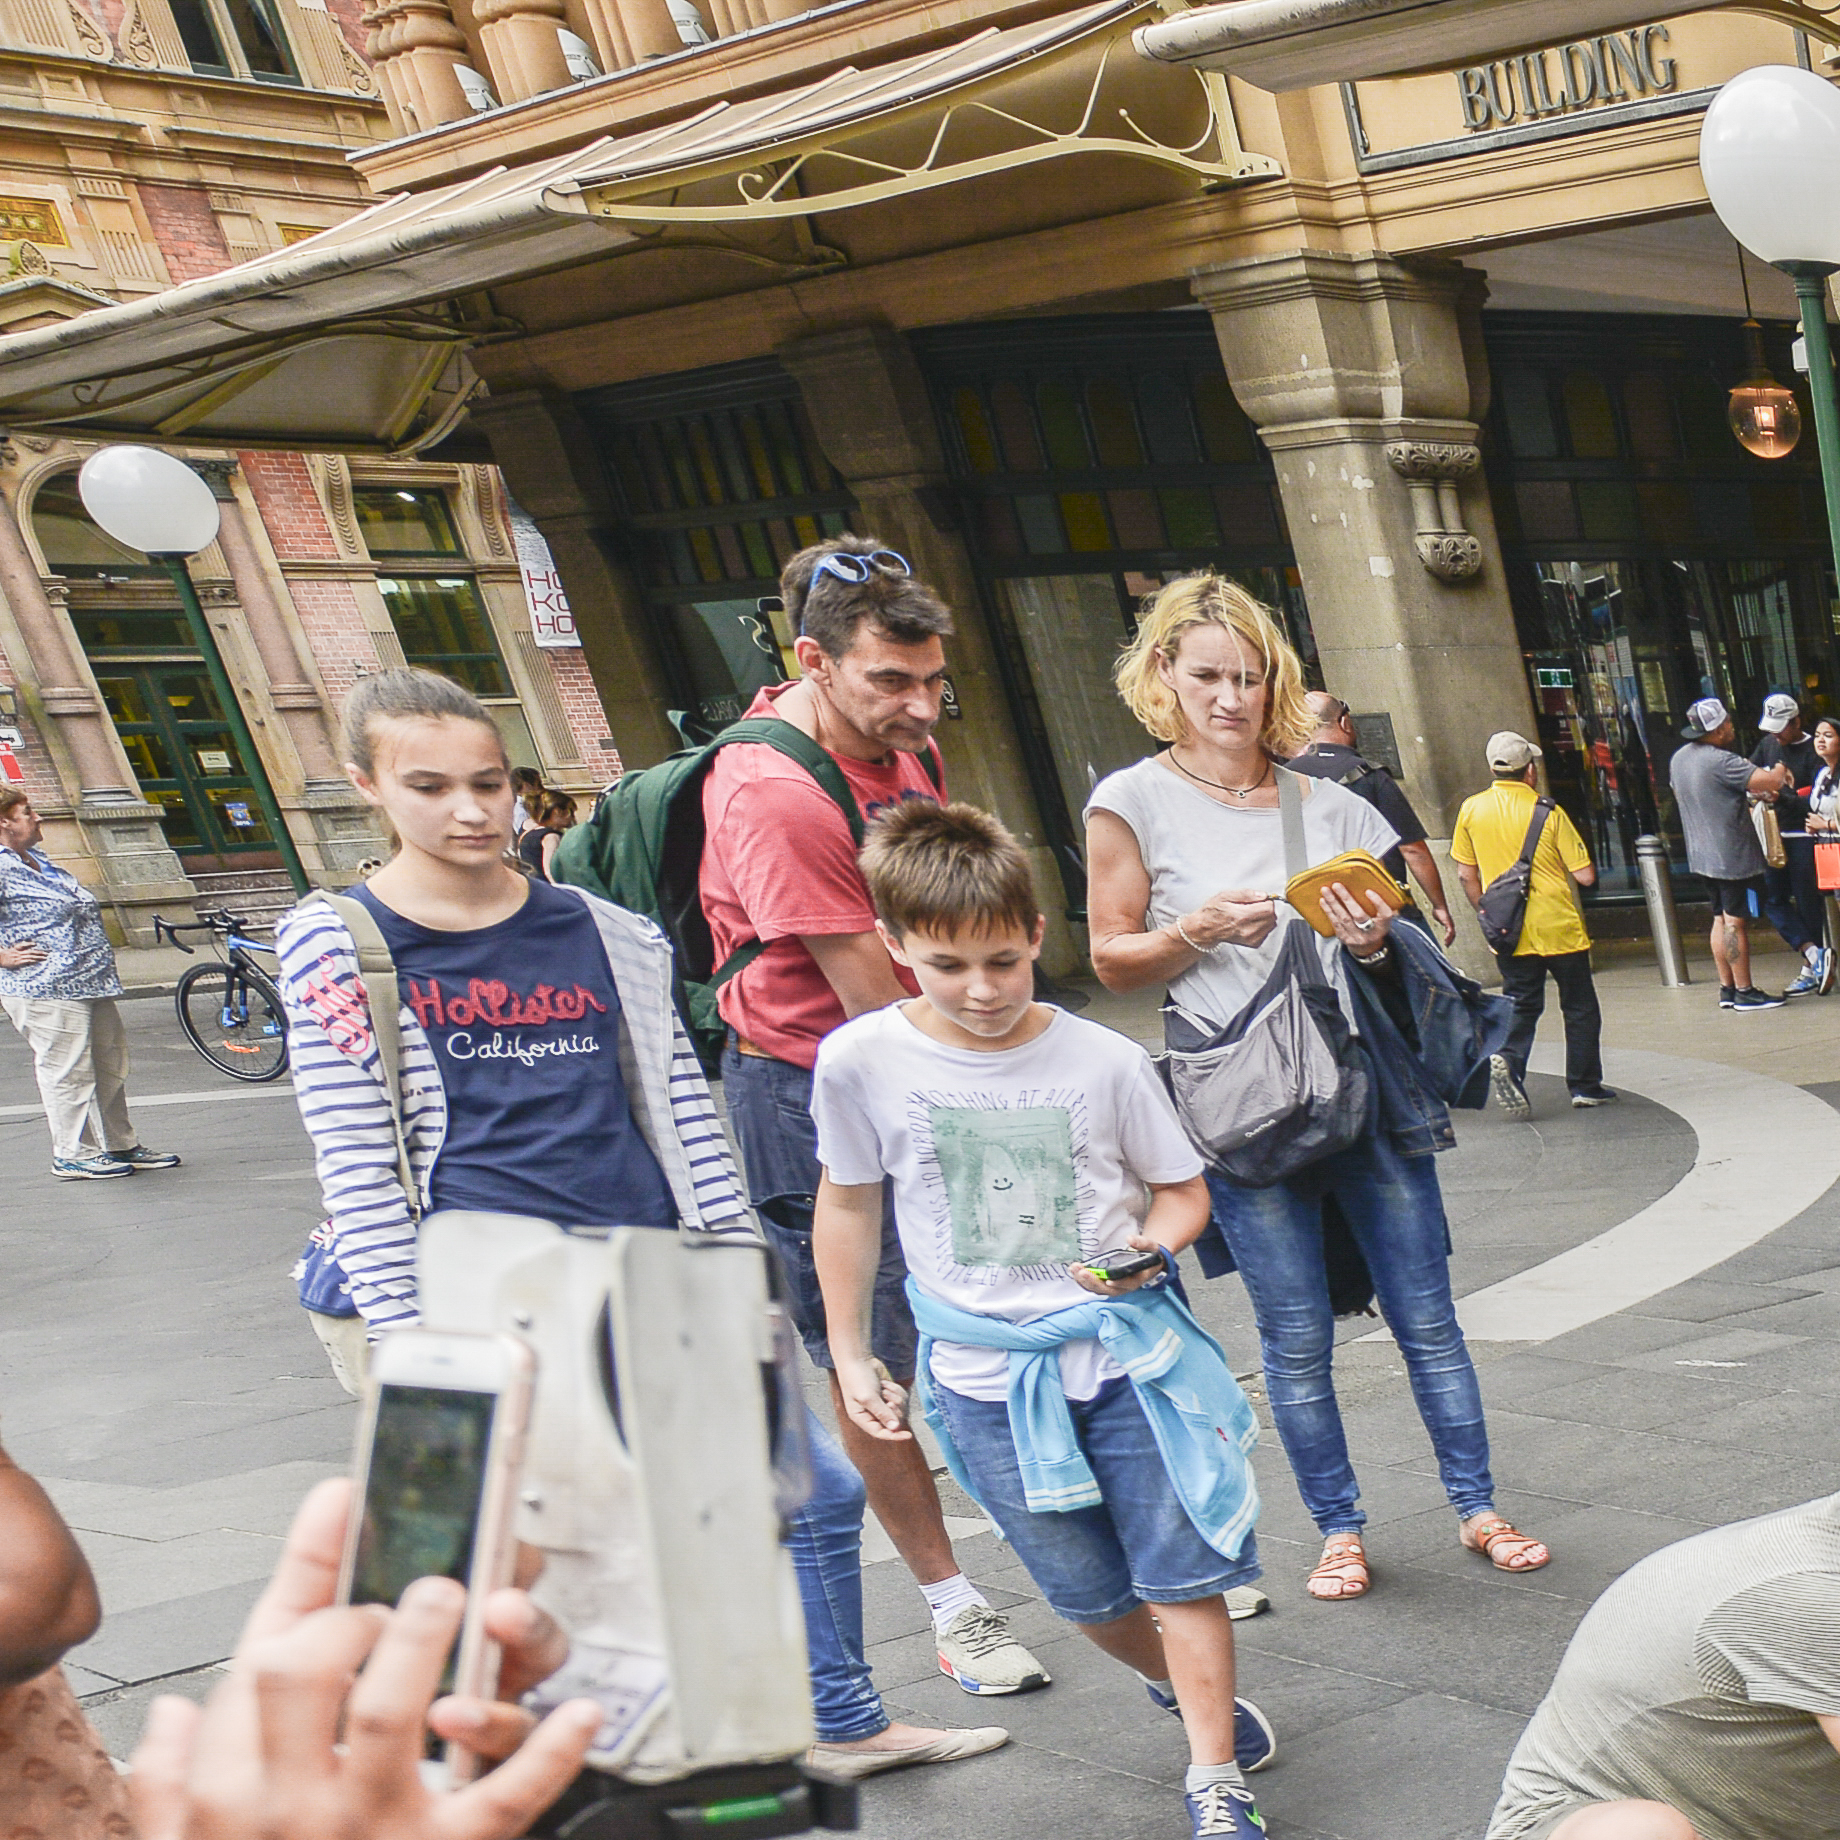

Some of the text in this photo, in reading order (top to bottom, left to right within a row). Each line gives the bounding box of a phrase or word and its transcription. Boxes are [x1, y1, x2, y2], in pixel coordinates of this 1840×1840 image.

[1454, 24, 1676, 128] BUILDING
[409, 978, 607, 1028] Hollister
[446, 1032, 599, 1066] California
[1017, 1090, 1040, 1109] AT
[1008, 1261, 1075, 1282] OTHING
